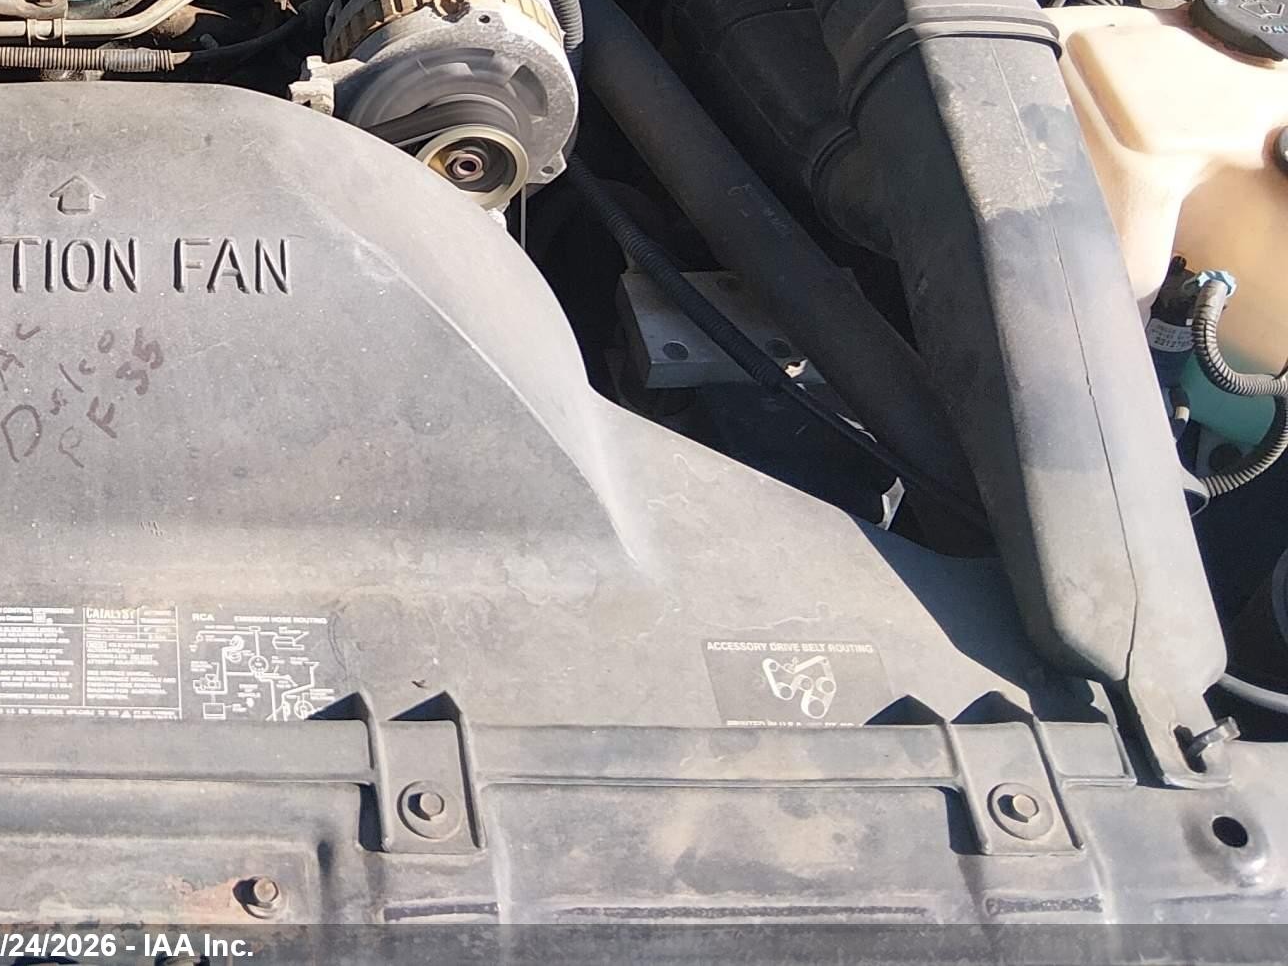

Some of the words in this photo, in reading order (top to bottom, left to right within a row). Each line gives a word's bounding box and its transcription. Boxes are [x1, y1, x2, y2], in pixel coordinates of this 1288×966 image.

[171, 235, 293, 295] FAN
[86, 607, 135, 619] CATALYST
[191, 613, 215, 622] RCA
[707, 641, 768, 652] ACCESSORY
[770, 641, 801, 652] DRIVE
[802, 642, 826, 653] BELT
[828, 643, 874, 654] ROUTING
